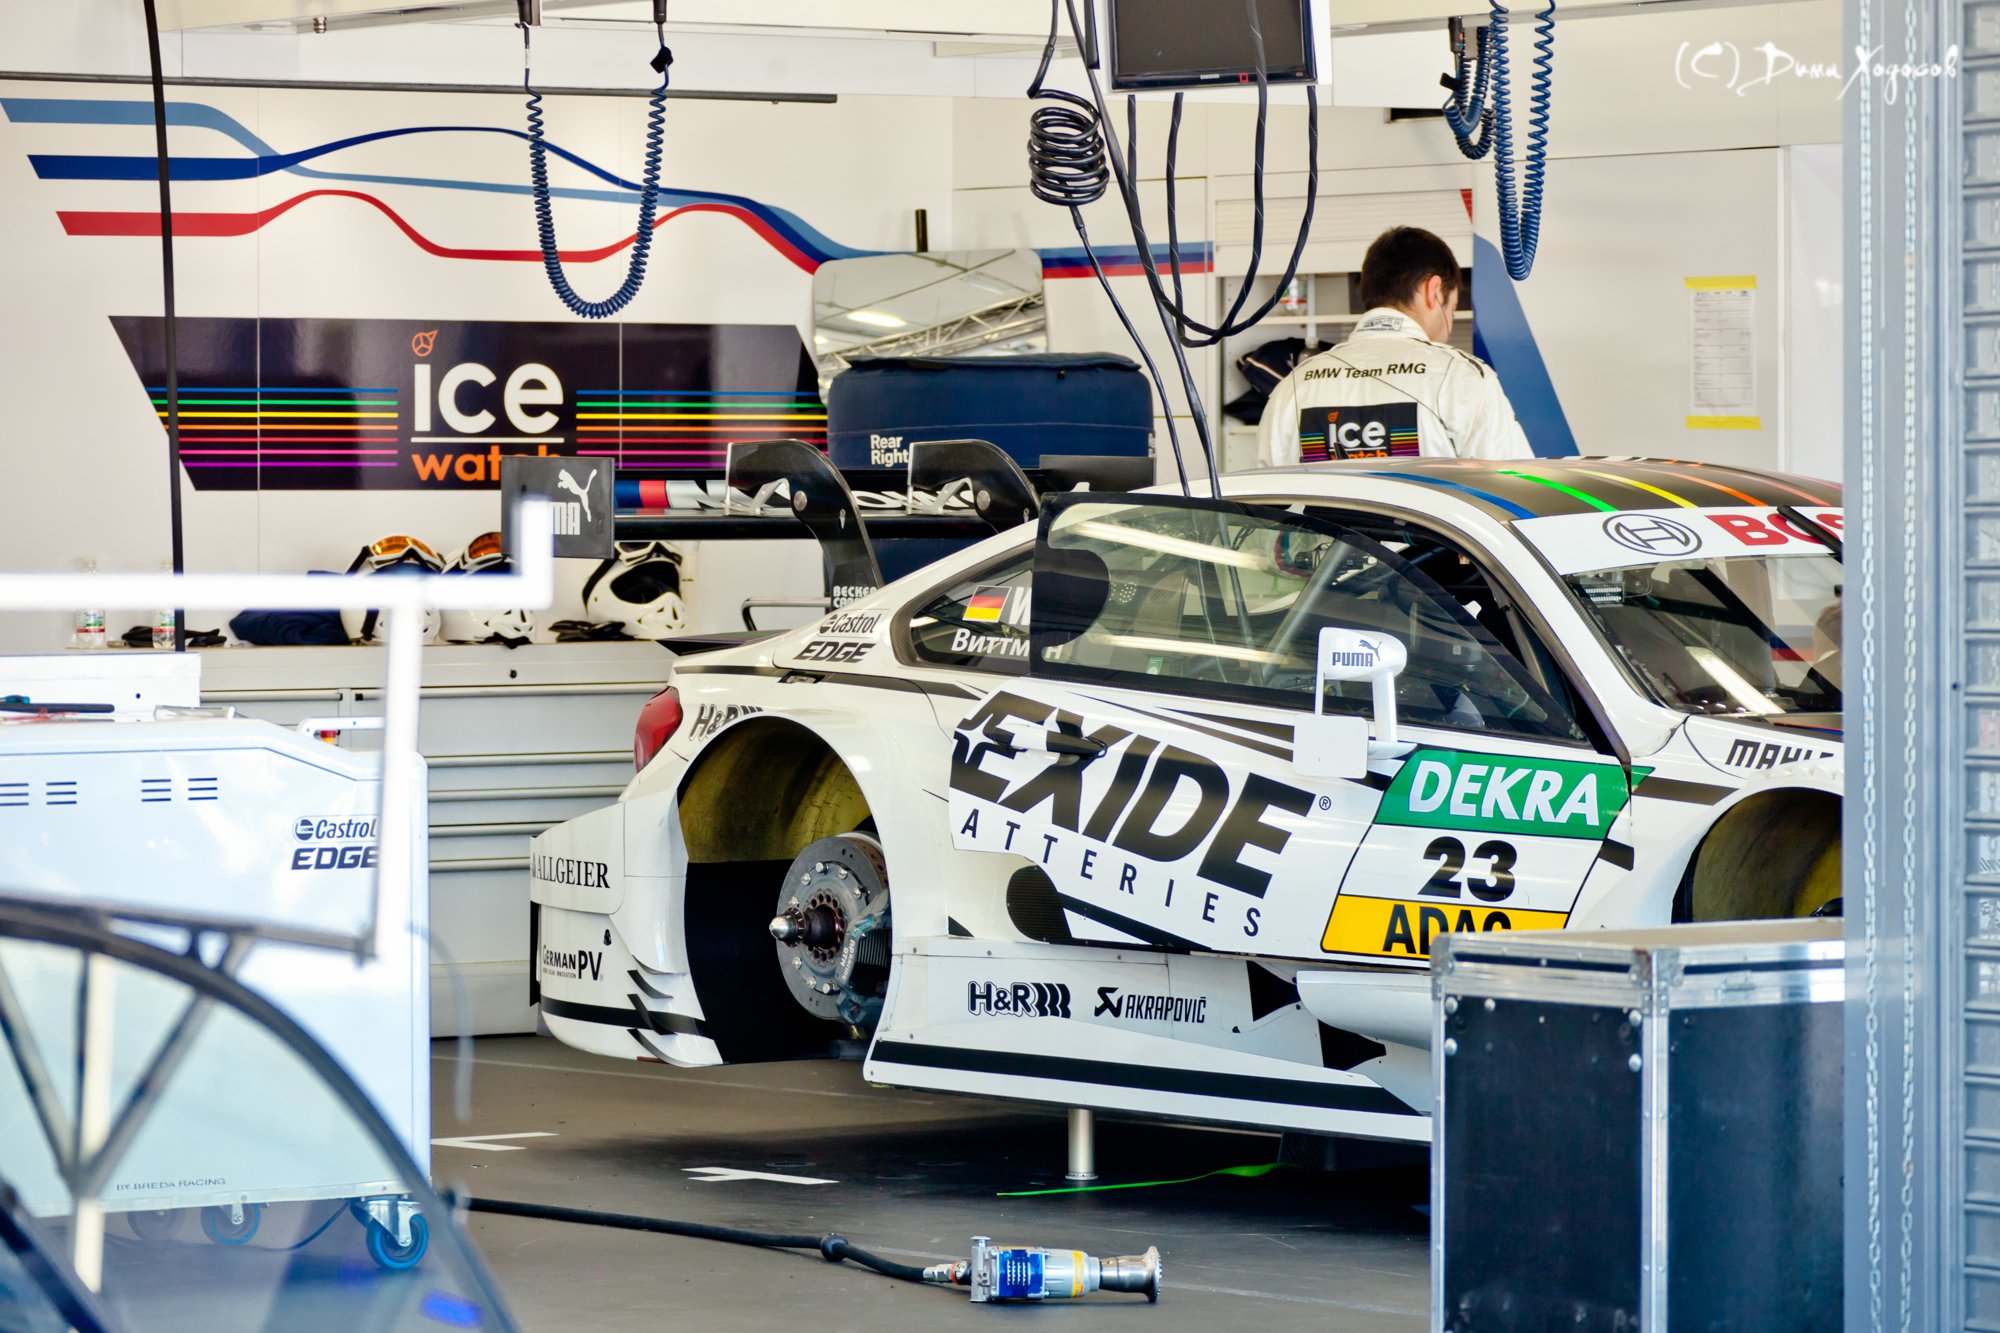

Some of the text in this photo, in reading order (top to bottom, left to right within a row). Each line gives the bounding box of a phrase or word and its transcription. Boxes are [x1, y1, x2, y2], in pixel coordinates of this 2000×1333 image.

[1304, 363, 1427, 382] BMW Team RMG
[414, 362, 564, 434] ice
[870, 434, 903, 449] Rear
[1328, 421, 1386, 448] ice
[411, 445, 561, 481] wat
[871, 449, 910, 467] Right
[831, 613, 882, 633] Castrol
[792, 641, 876, 663] EDGE
[951, 628, 1064, 660] Виттмн
[1332, 652, 1374, 667] PUMA
[949, 690, 1317, 899] EXIDE
[1408, 760, 1600, 826] DEKRA
[315, 818, 377, 840] Castrol
[291, 846, 379, 870] EDGE
[537, 854, 611, 889] ALLGEIER
[1417, 836, 1518, 902] 23
[578, 950, 602, 981] PV
[968, 980, 1037, 1017] H&R
[1125, 995, 1207, 1024] AKRAPOVIČ
[116, 1178, 226, 1192] BY BREDA RACING
